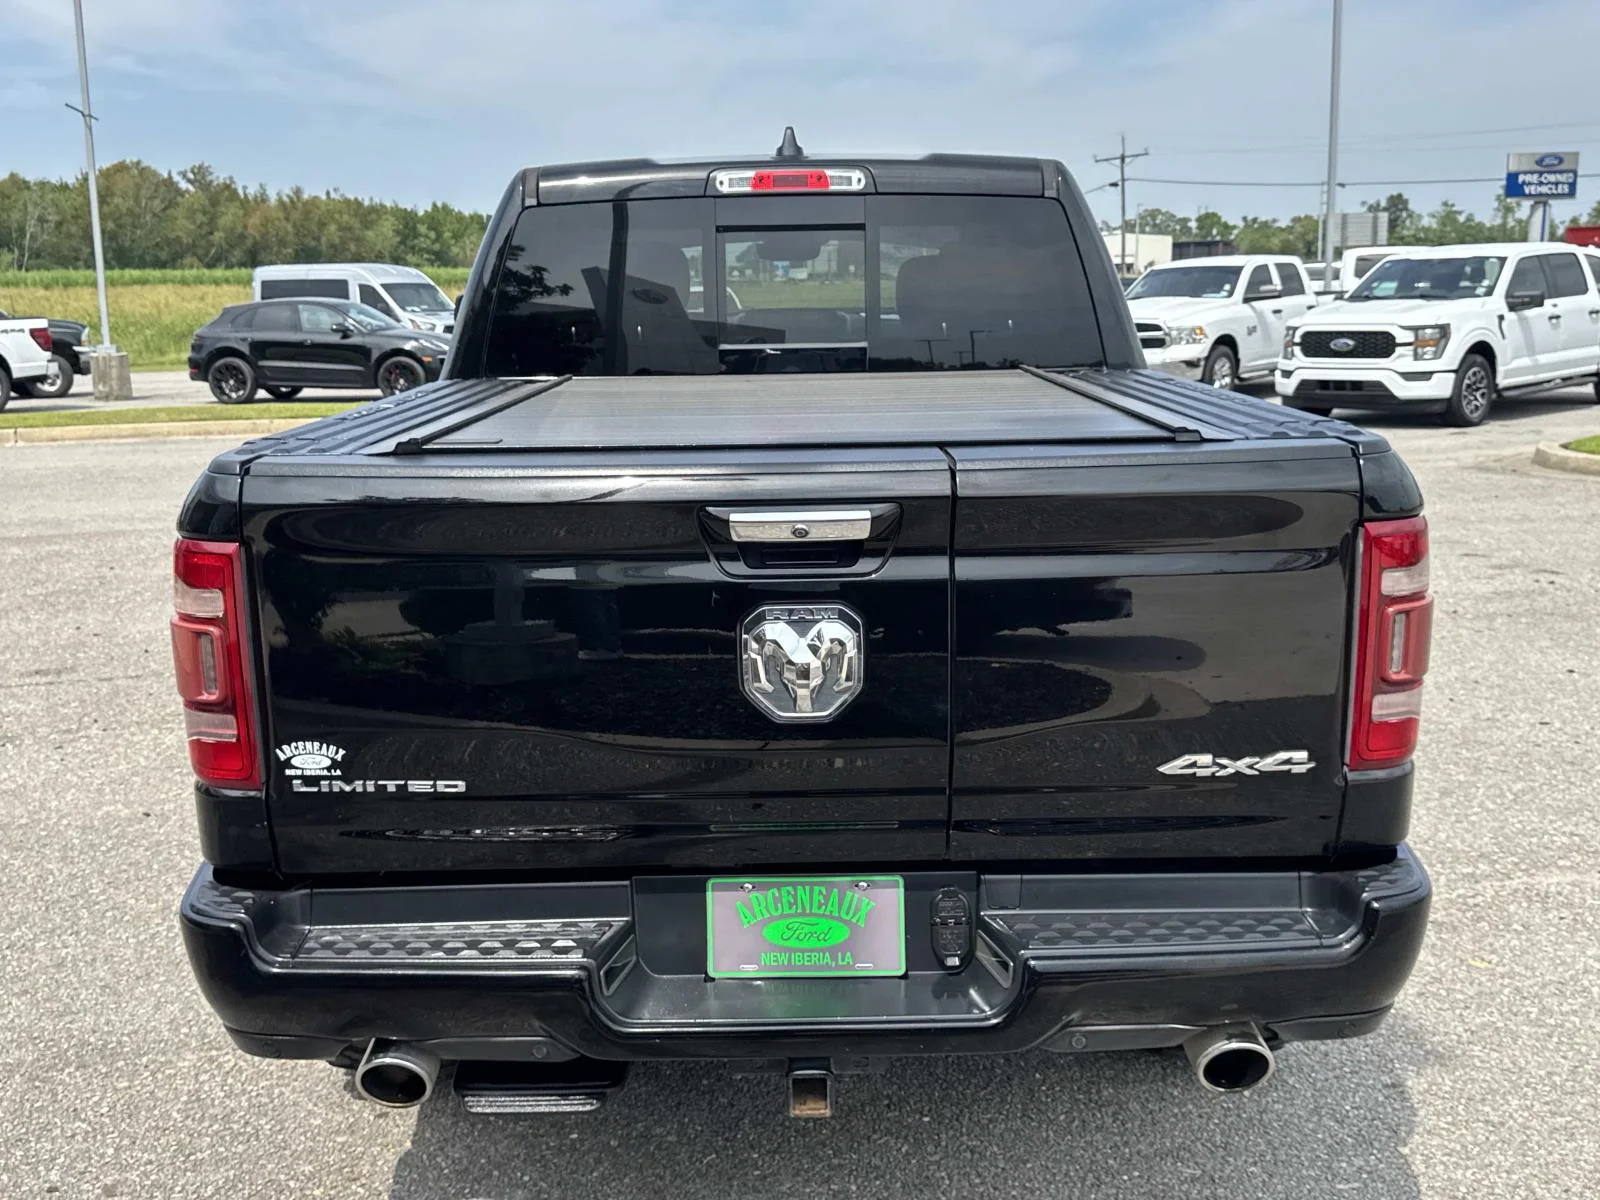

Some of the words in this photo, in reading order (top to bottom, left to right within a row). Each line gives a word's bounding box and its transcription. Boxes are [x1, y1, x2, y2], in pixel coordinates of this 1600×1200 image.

[1518, 173, 1574, 184] PRE-OWNED
[1523, 184, 1569, 195] VEHICLES
[765, 607, 839, 620] RAM
[275, 741, 346, 762] ARCENEAUX
[292, 780, 466, 793] LIMITED
[736, 885, 876, 929] ARCENEAUX
[781, 921, 832, 942] Ford
[761, 953, 788, 966] NEW
[791, 952, 835, 967] IBERIA,
[838, 952, 853, 965] LA
